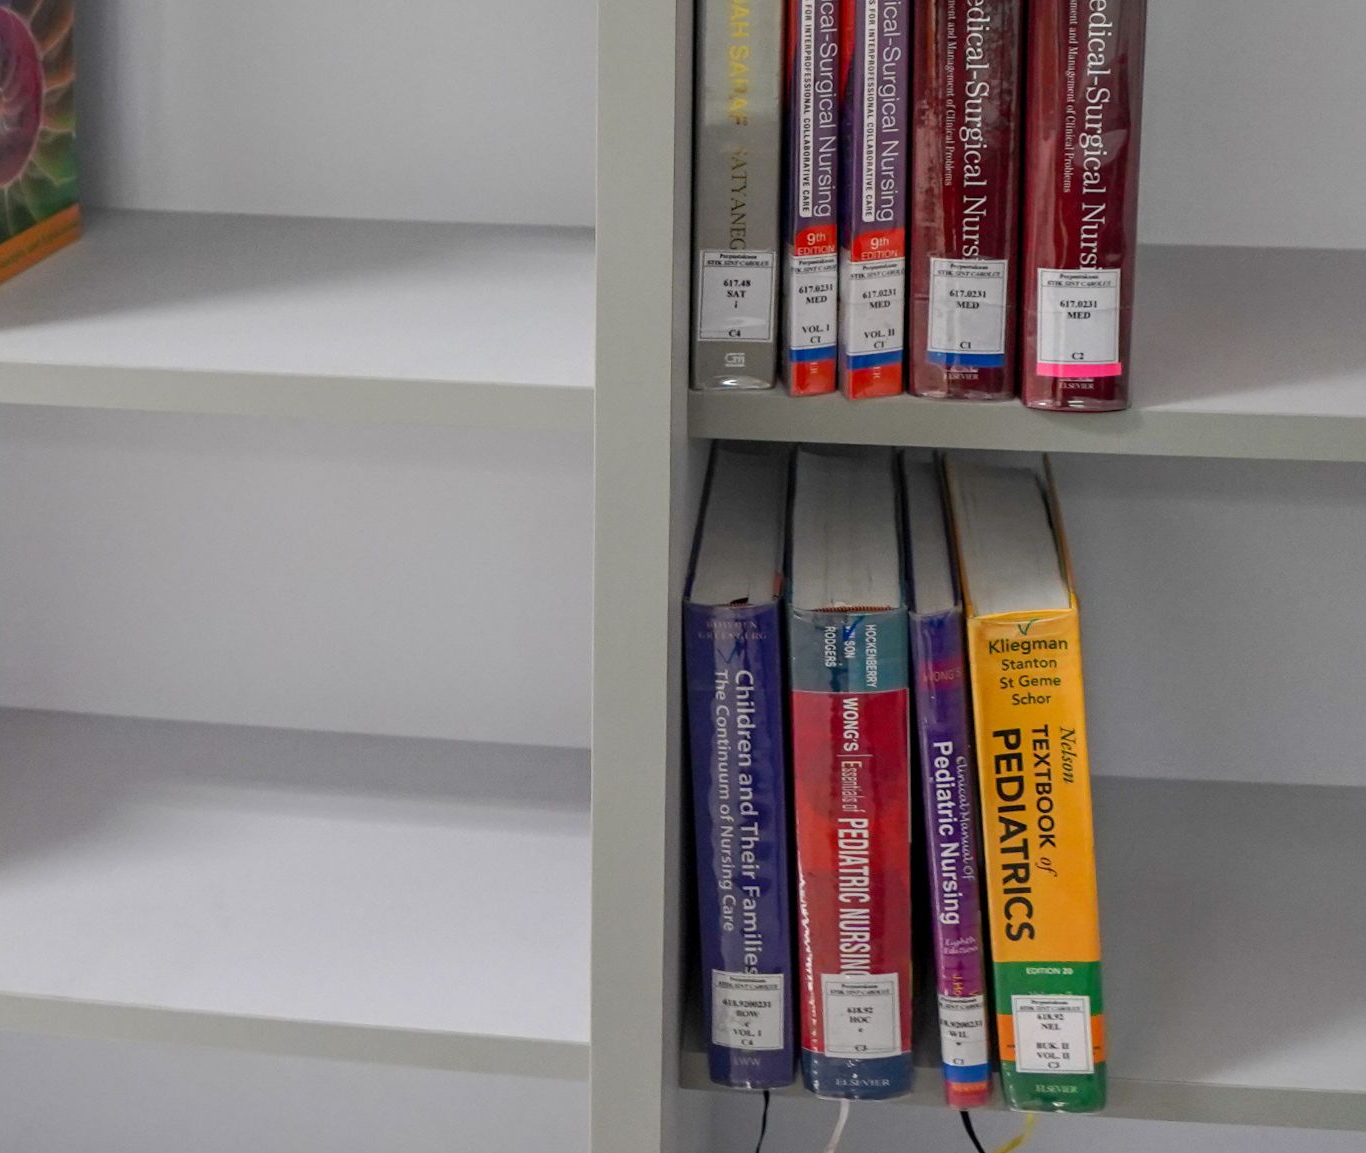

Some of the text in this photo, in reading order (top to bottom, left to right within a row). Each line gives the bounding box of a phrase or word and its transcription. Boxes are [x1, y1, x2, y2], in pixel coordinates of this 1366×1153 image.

[805, 5, 813, 21] FOR
[803, 24, 812, 115] INTERPROFESSIONAL
[803, 118, 811, 181] COLLABORATIVE
[814, 136, 837, 217] Nursing
[876, 139, 899, 222] Nursing
[797, 246, 834, 256] EDITION
[807, 232, 826, 246] 9th
[1060, 300, 1098, 309] 617.0231
[1067, 311, 1091, 320] MED
[825, 626, 837, 668] RODGERS
[864, 624, 878, 688] HOCKENBERRY
[988, 637, 1068, 656] Kliegman
[1001, 656, 1057, 670] Stanton
[1000, 674, 1061, 688] St Geme
[1011, 691, 1051, 706] Schor
[842, 698, 860, 752] WONG'S
[840, 760, 865, 802] Essentials
[1060, 726, 1076, 784] Nelson
[715, 669, 737, 932] The Continuum of Nursing Care
[735, 669, 763, 975] Children and Their Families
[1031, 724, 1057, 878] TEXTBOOK of
[838, 817, 870, 903] PEDIATRIC
[932, 741, 964, 926] Pediatric Nursing
[992, 728, 1035, 943] PEDIATRICS
[1025, 966, 1074, 976] EDITION 20
